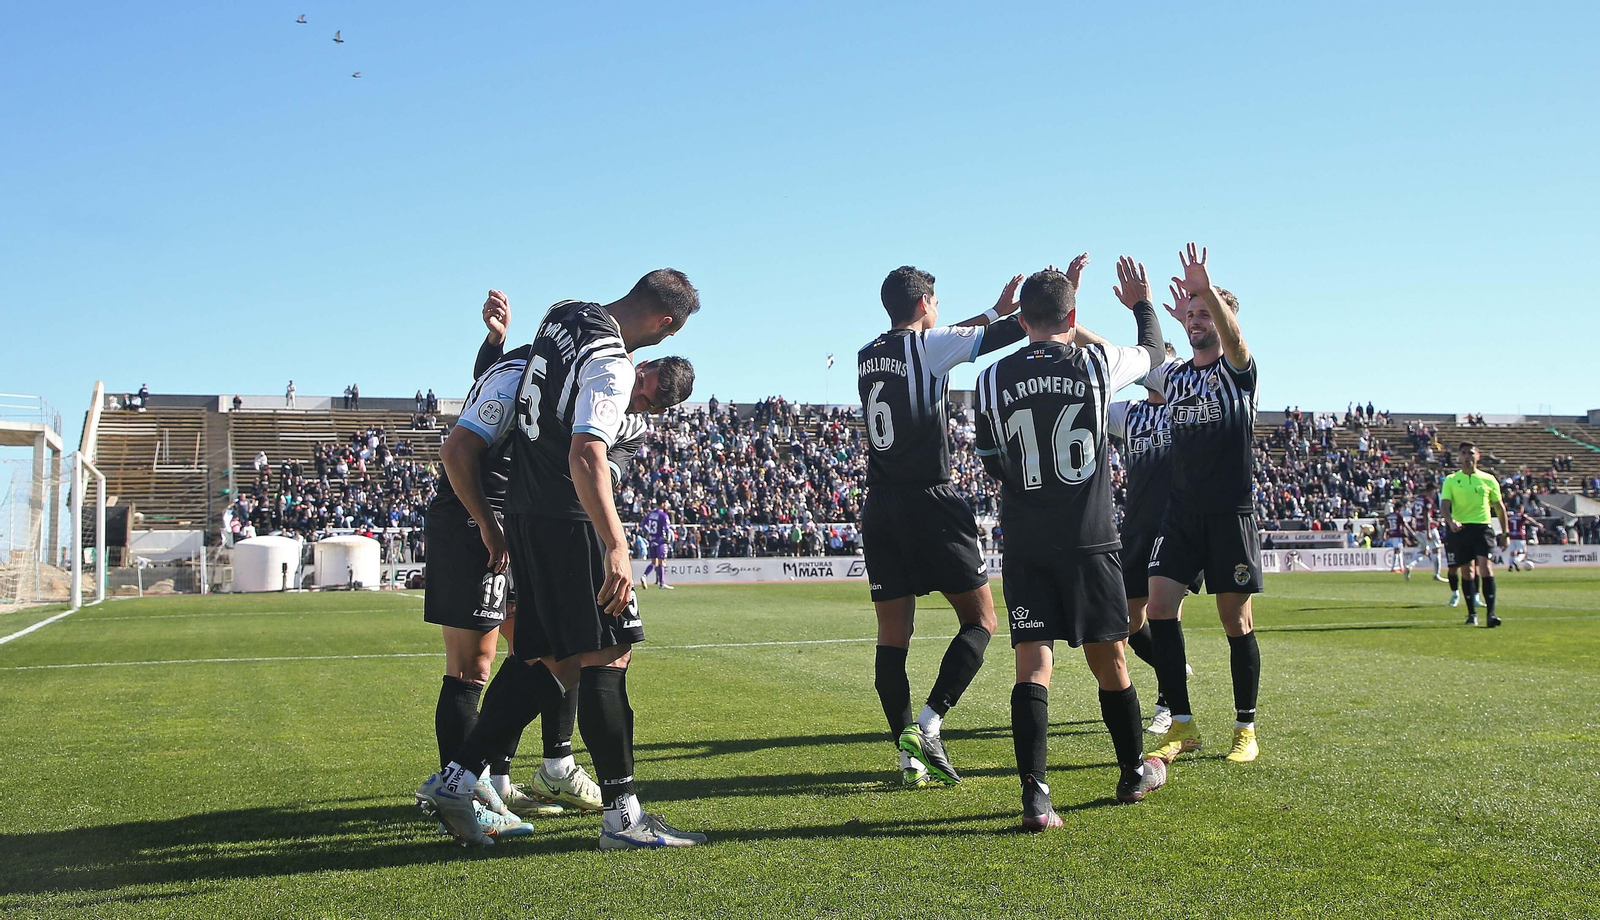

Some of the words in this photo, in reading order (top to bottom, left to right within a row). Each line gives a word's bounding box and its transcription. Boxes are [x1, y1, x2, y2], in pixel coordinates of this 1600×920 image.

[517, 354, 547, 442] 5
[1002, 376, 1086, 407] A.ROMERO
[867, 381, 895, 451] 6
[1005, 403, 1097, 491] 16
[1323, 551, 1377, 567] FEDERACIÓN
[1563, 552, 1598, 562] carmali
[799, 568, 834, 577] MATA
[482, 572, 506, 608] 19
[473, 609, 504, 620] LEGEA
[1018, 619, 1045, 629] Galán
